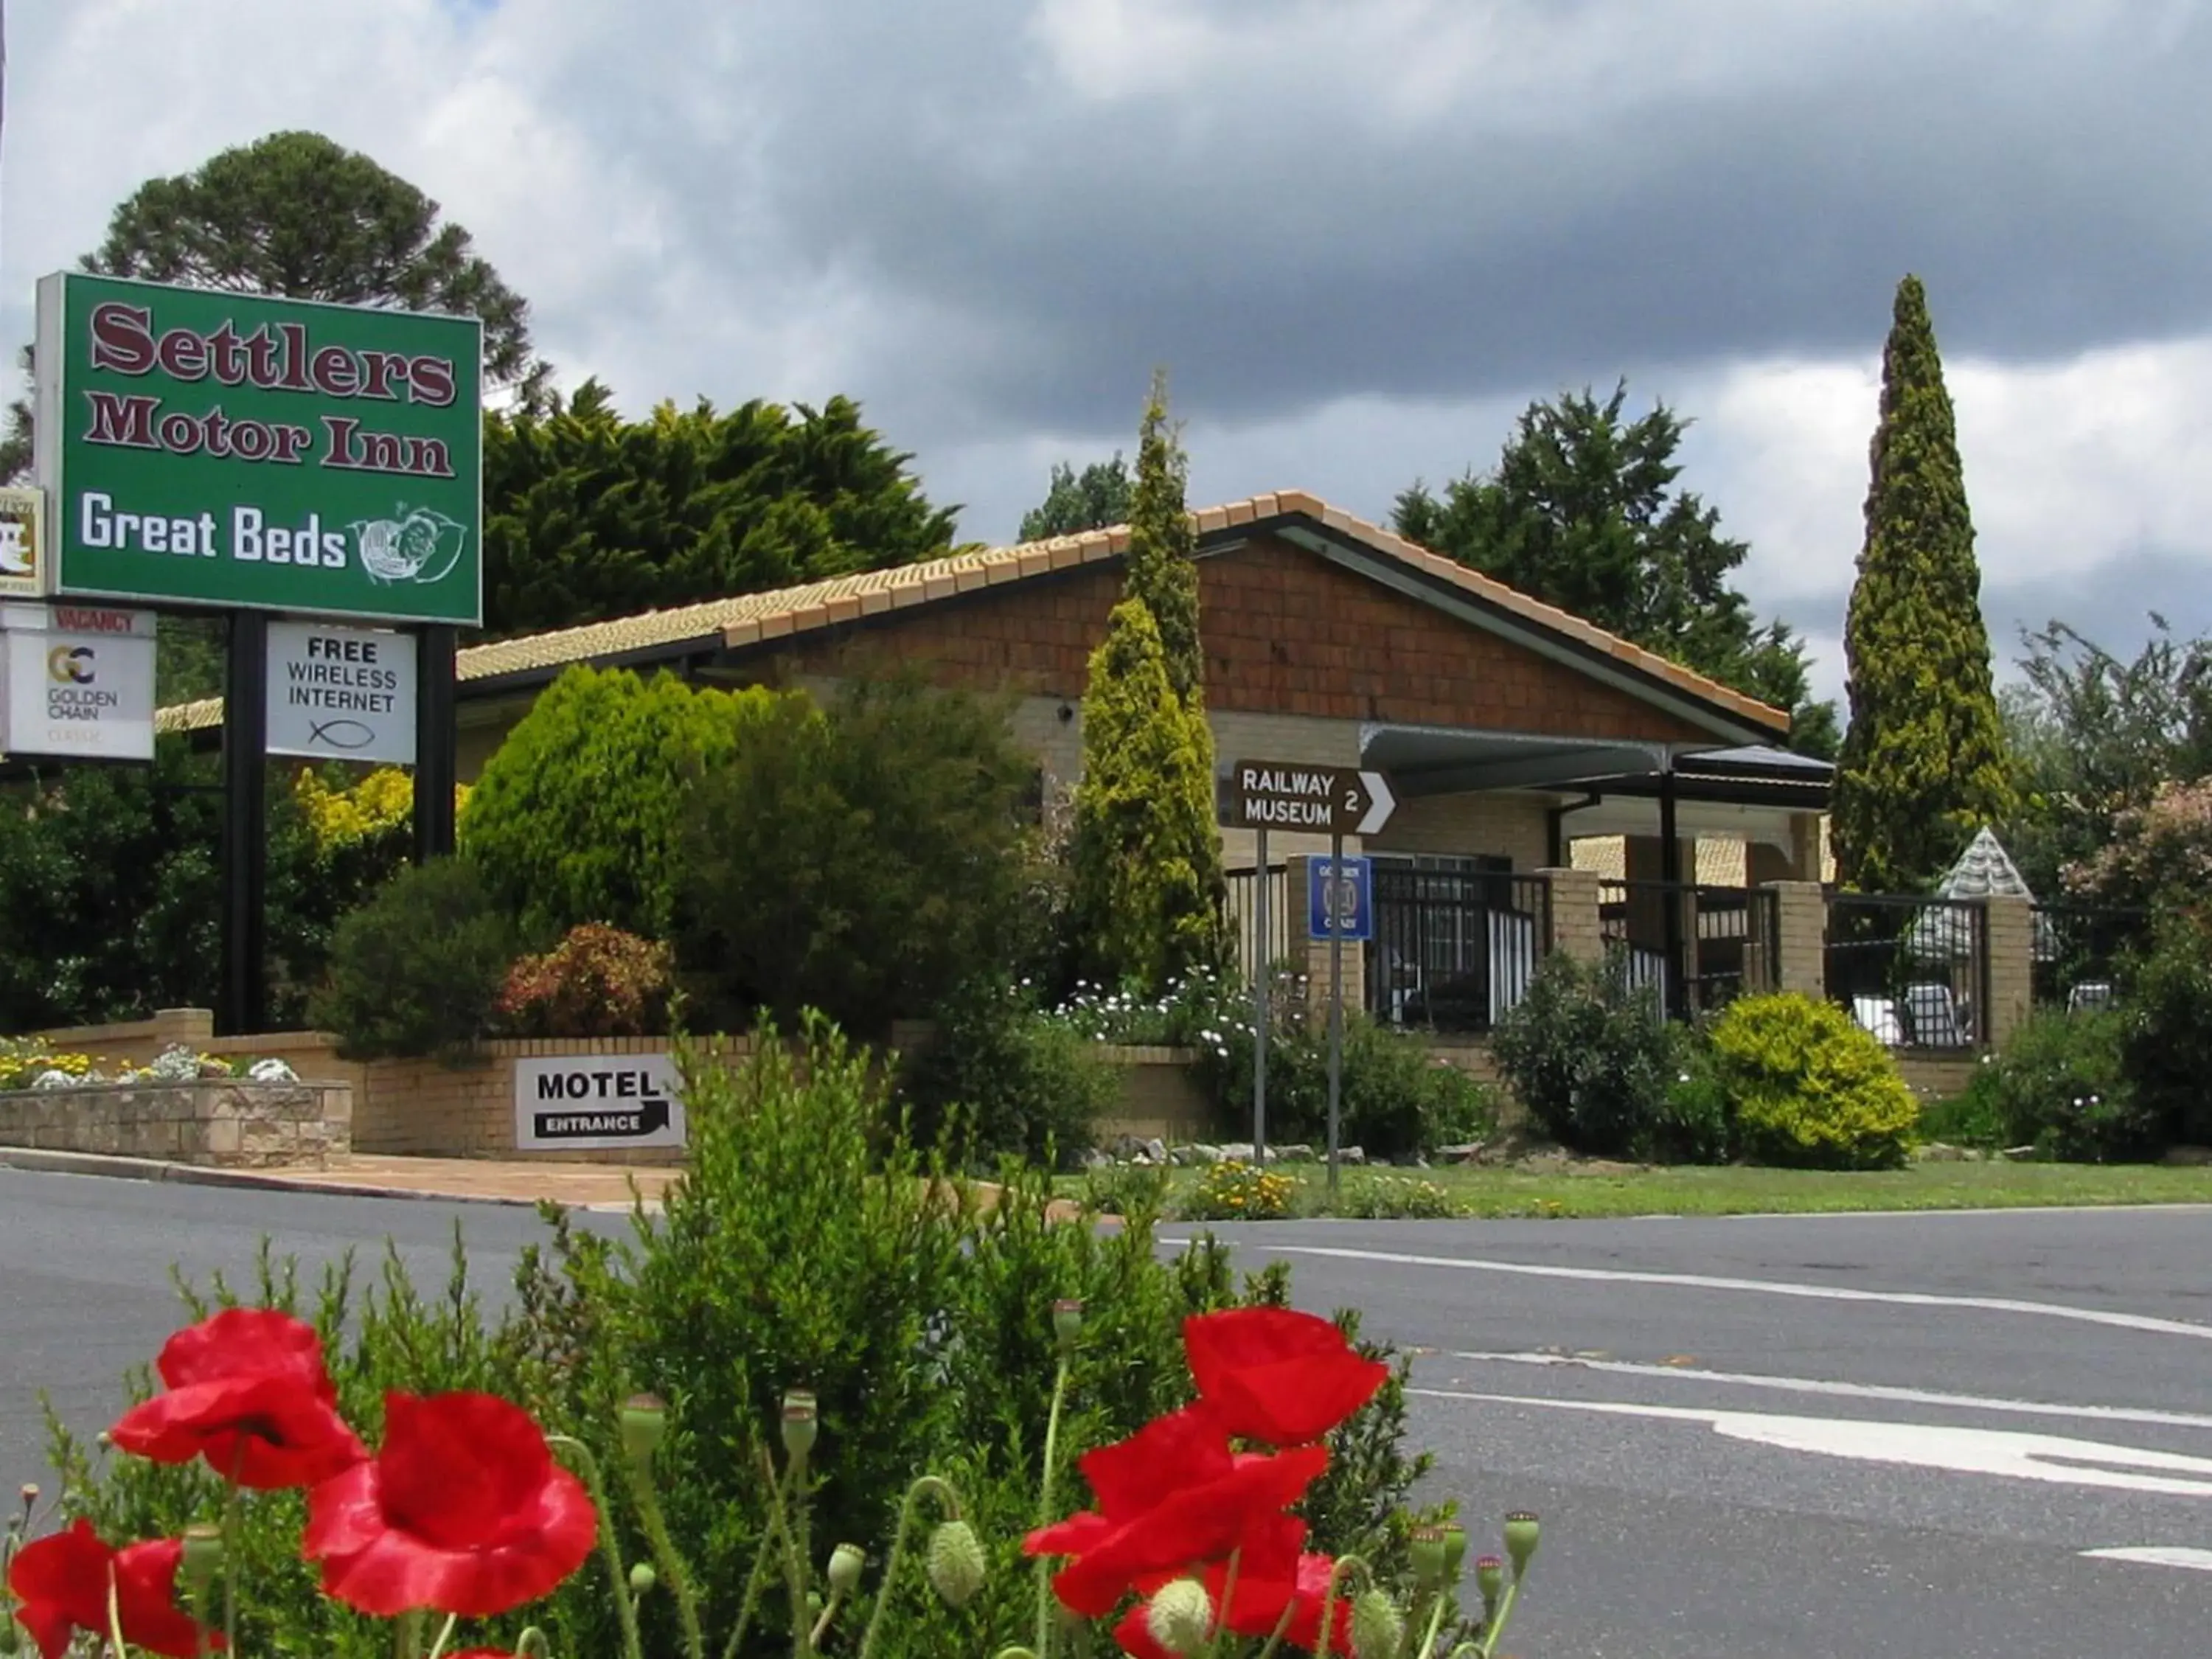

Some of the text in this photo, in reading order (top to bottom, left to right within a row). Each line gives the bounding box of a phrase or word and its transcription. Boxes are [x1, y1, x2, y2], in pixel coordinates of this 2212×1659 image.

[91, 302, 457, 406] Settlers
[83, 391, 456, 478] Motor Inn
[82, 492, 347, 569] Great Beds
[54, 607, 134, 632] VACANCY
[308, 637, 378, 664] FREE
[287, 661, 397, 689] WIRELESS
[48, 688, 116, 706] GOLDEN
[289, 686, 395, 712] INTERNET
[48, 705, 99, 720] CHAIN
[1242, 769, 1335, 796] RAILWAY
[1245, 798, 1332, 825] MUSEUM
[1345, 790, 1358, 811] 2
[537, 1071, 660, 1099] MOTEL
[546, 1115, 640, 1132] ENTRANCE
